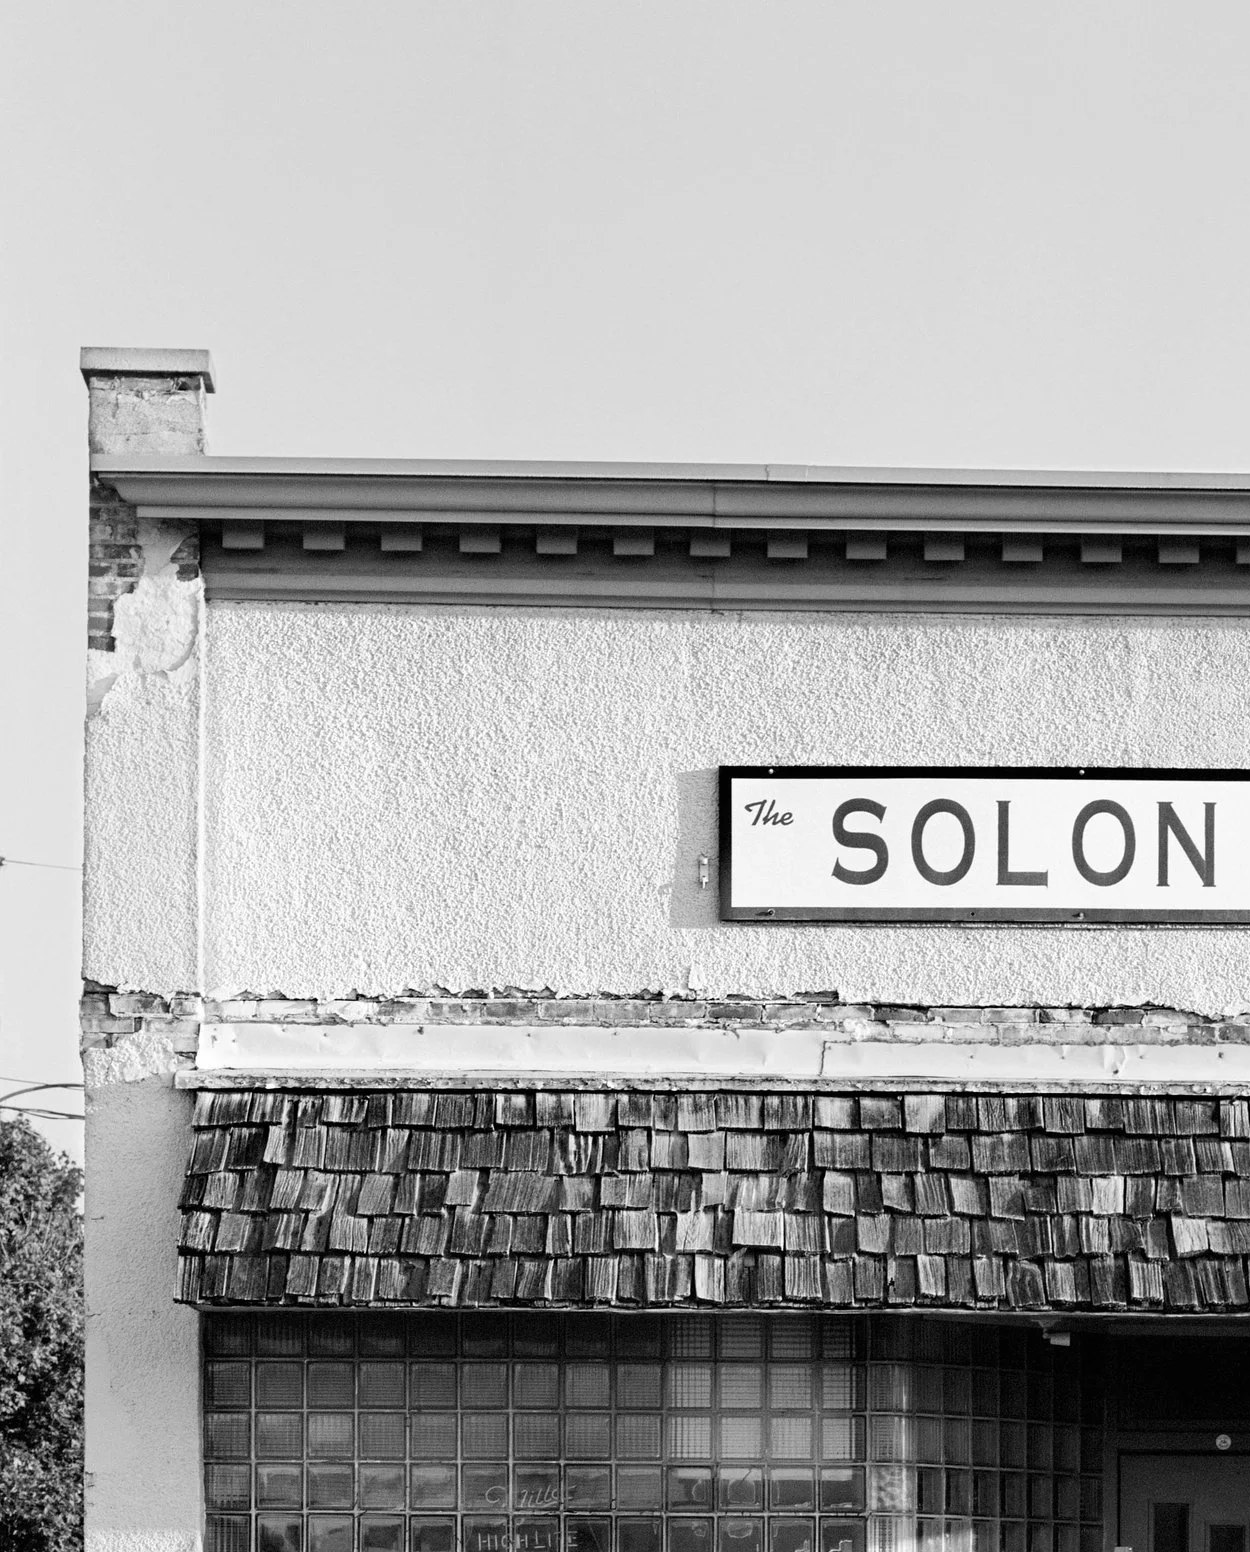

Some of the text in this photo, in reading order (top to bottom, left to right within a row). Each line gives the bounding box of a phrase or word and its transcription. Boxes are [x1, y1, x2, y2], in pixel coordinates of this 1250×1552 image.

[744, 799, 794, 826] The
[831, 798, 1217, 888] SOLON
[534, 1530, 578, 1549] LIE
